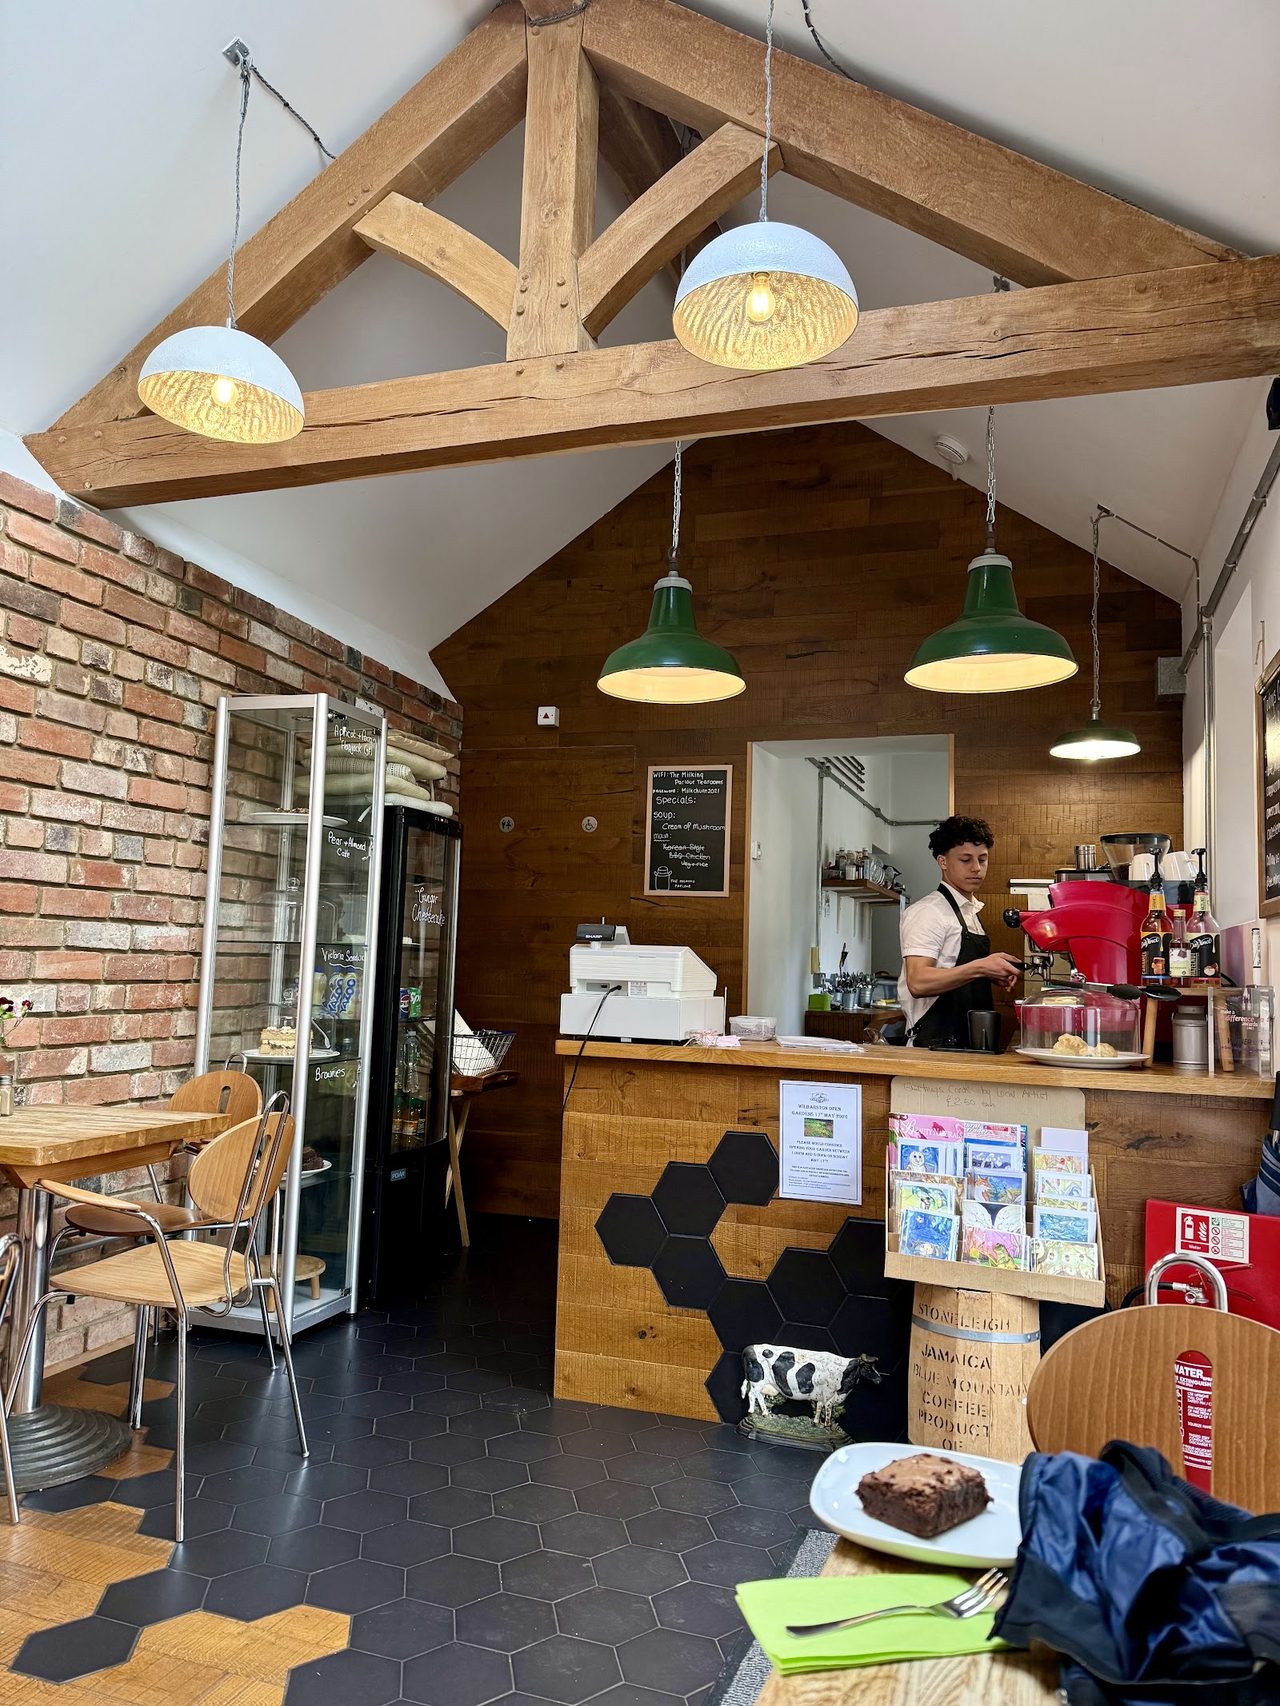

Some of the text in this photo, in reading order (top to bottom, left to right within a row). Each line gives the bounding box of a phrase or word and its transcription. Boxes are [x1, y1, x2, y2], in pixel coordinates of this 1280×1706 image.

[681, 771, 704, 780] Milking
[662, 822, 682, 830] Cream
[683, 822, 692, 831] of
[328, 830, 342, 846] Pear
[348, 836, 367, 851] Almond
[320, 947, 344, 962] Victoria
[314, 1066, 346, 1082] Brownies
[996, 1087, 1016, 1099] Local
[918, 1304, 1010, 1331] STONELEIGH
[922, 1344, 992, 1370] JAMAICA
[913, 1363, 940, 1385] BLUE
[922, 1391, 987, 1418] COFFEE
[918, 1408, 990, 1438] PRODUCT
[942, 1438, 963, 1451] OF
